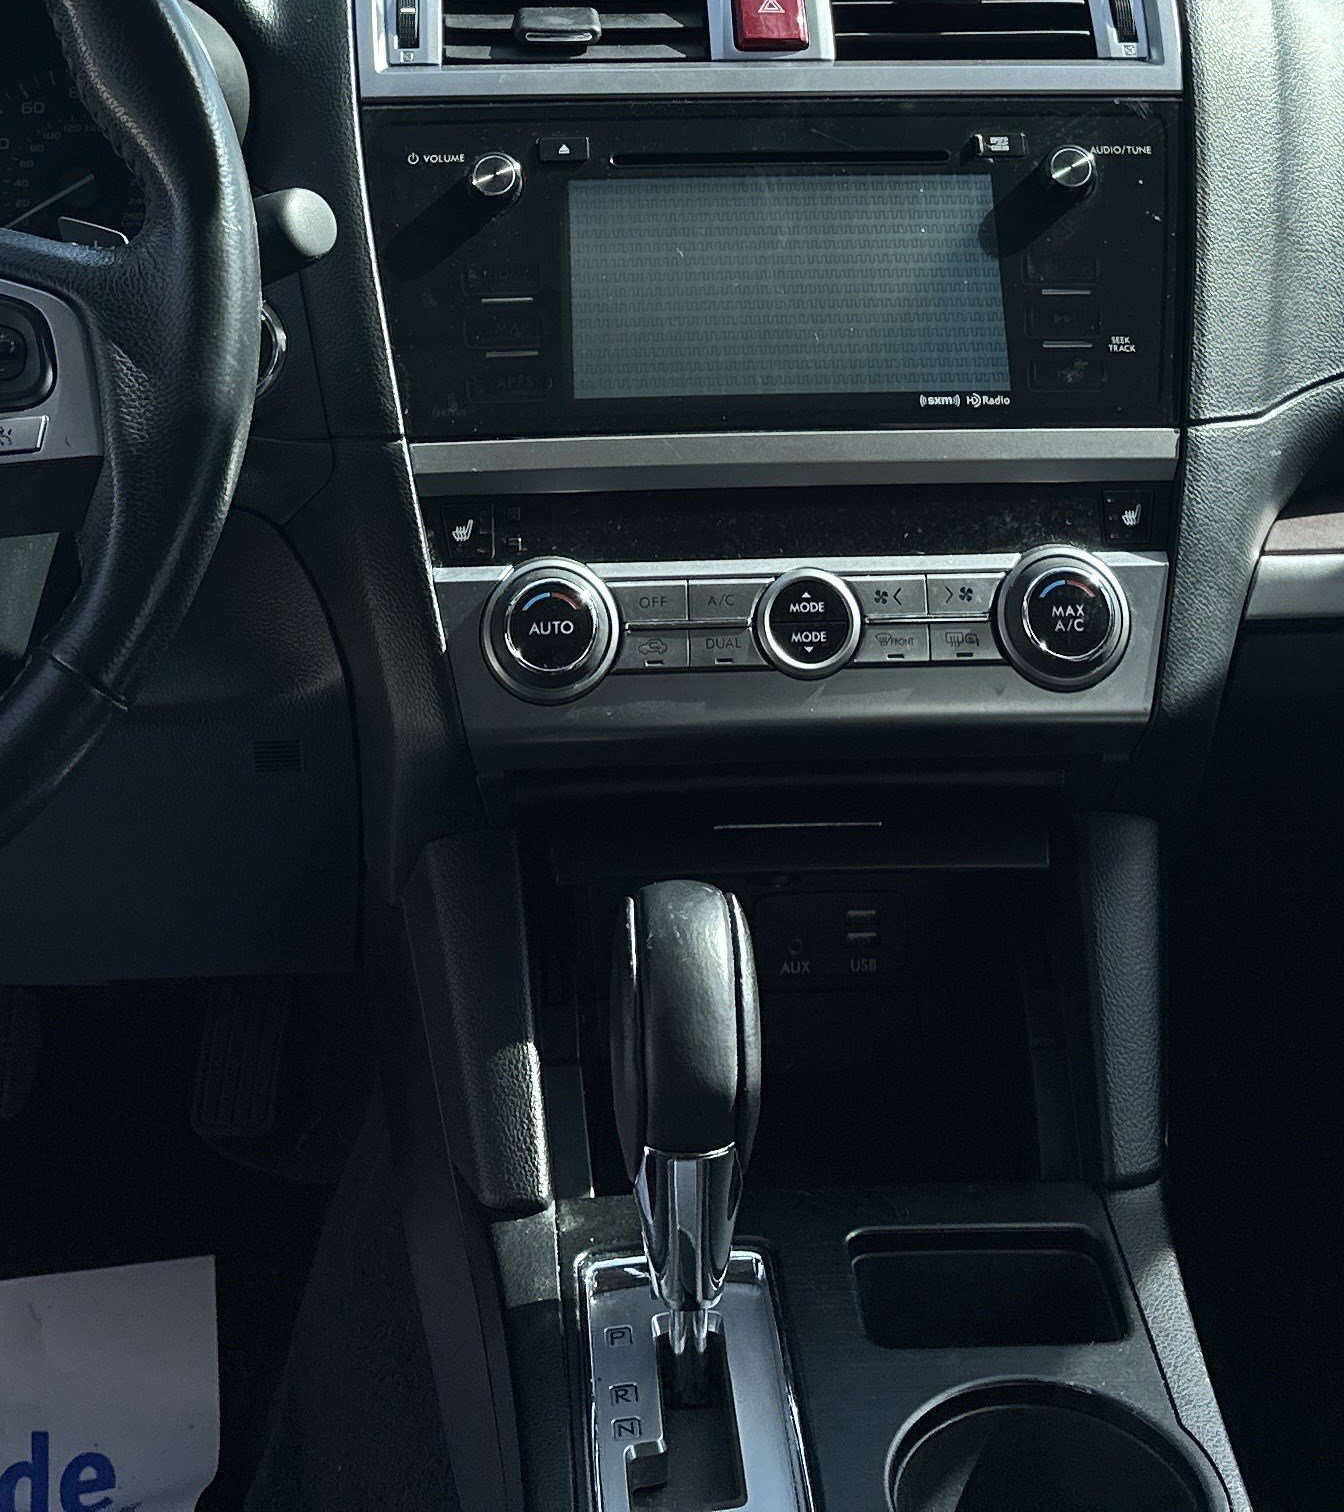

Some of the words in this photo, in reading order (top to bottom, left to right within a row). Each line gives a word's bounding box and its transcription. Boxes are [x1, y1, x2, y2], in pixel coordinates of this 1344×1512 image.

[21, 101, 45, 114] 60
[1090, 145, 1152, 155] AUDIO/TUNE
[423, 153, 465, 163] VOLUME
[1111, 336, 1131, 344] SEEK
[1108, 344, 1136, 353] TRACK
[982, 395, 1010, 405] Radio
[639, 595, 667, 610] OFF
[707, 594, 735, 608] A/C
[789, 601, 825, 614] MODE
[1052, 604, 1085, 618] MAX
[529, 620, 574, 636] AUTO
[1054, 619, 1085, 632] A/C
[791, 631, 827, 643] MODE
[705, 637, 742, 650] DUAL
[781, 960, 810, 974] AUX
[850, 958, 877, 972] USB
[609, 1330, 626, 1346] P
[614, 1391, 629, 1403] R
[618, 1423, 634, 1435] N
